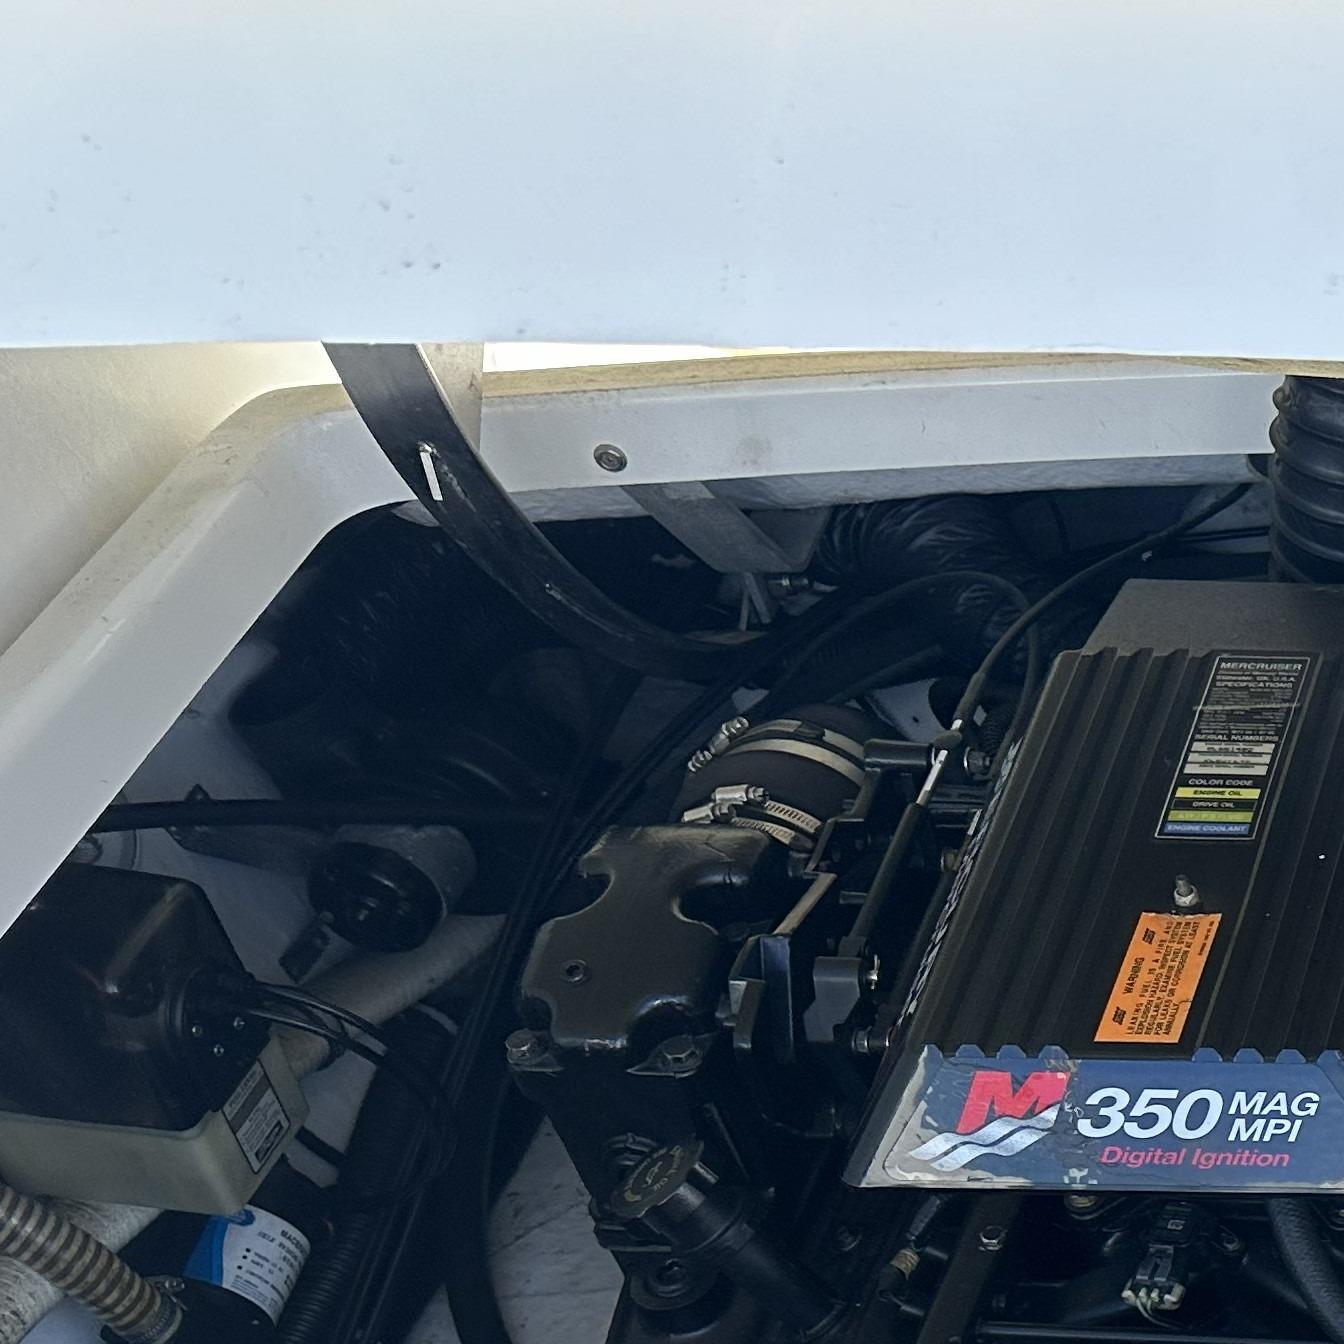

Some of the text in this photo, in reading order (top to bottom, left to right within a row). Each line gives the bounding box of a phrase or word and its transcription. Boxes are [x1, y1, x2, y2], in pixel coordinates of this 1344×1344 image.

[1220, 661, 1303, 671] MERCRUISER
[1215, 681, 1293, 689] SPECIFICATIONS
[1188, 778, 1253, 787] COLOR CODE
[1192, 789, 1226, 797] ENGINE
[1203, 825, 1247, 833] COOLANT
[1187, 921, 1200, 939] LEAST
[1169, 946, 1182, 962] FUEL
[1121, 957, 1145, 993] WARNING
[1166, 987, 1176, 997] OR
[1124, 1002, 1144, 1034] LEAKING
[1138, 981, 1152, 997] FUEL
[1158, 999, 1172, 1020] LEAKS
[1153, 1022, 1164, 1034] FOR
[1077, 1087, 1320, 1141] 350 MAG
[1227, 1118, 1303, 1143] MPI
[1100, 1146, 1290, 1170] Digital Ignition
